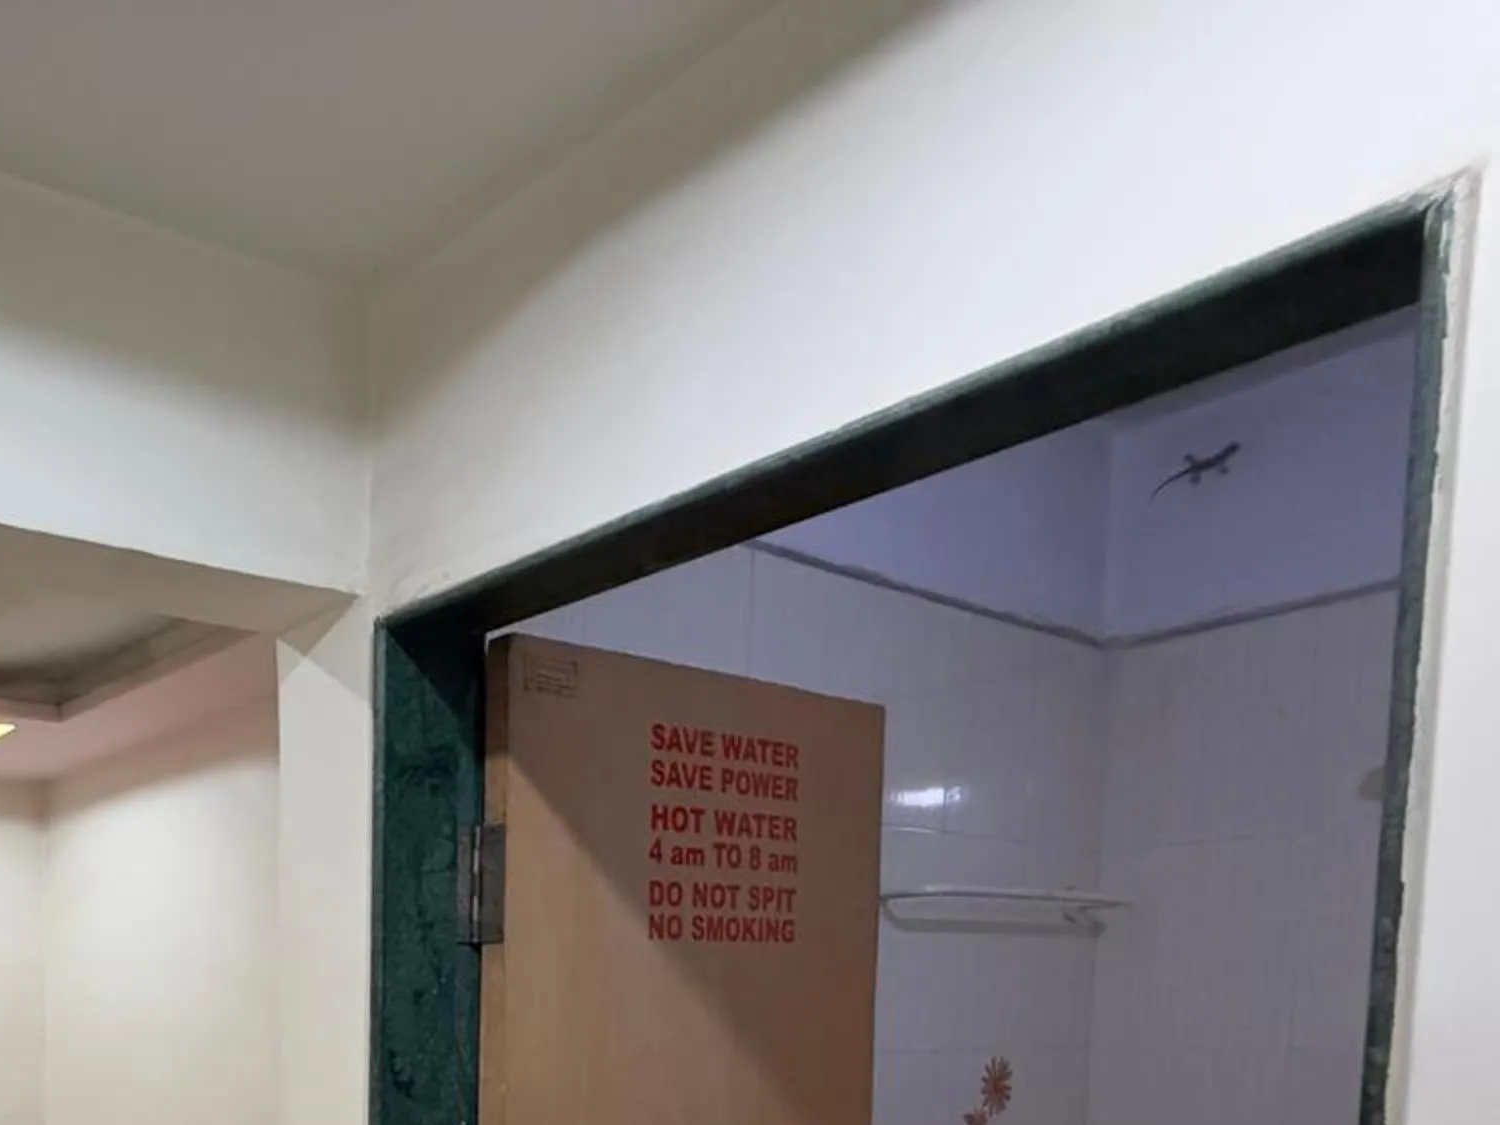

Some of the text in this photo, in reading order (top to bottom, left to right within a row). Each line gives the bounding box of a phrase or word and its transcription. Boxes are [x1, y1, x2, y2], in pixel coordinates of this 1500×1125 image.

[651, 723, 799, 769] SAVE WATER
[651, 759, 799, 803] SAVE POWER
[651, 804, 798, 842] HOT WATER
[649, 838, 798, 874] 4 am TO 8 am
[649, 880, 797, 912] DO NOT SPIT
[649, 913, 796, 943] NO SMOKING
